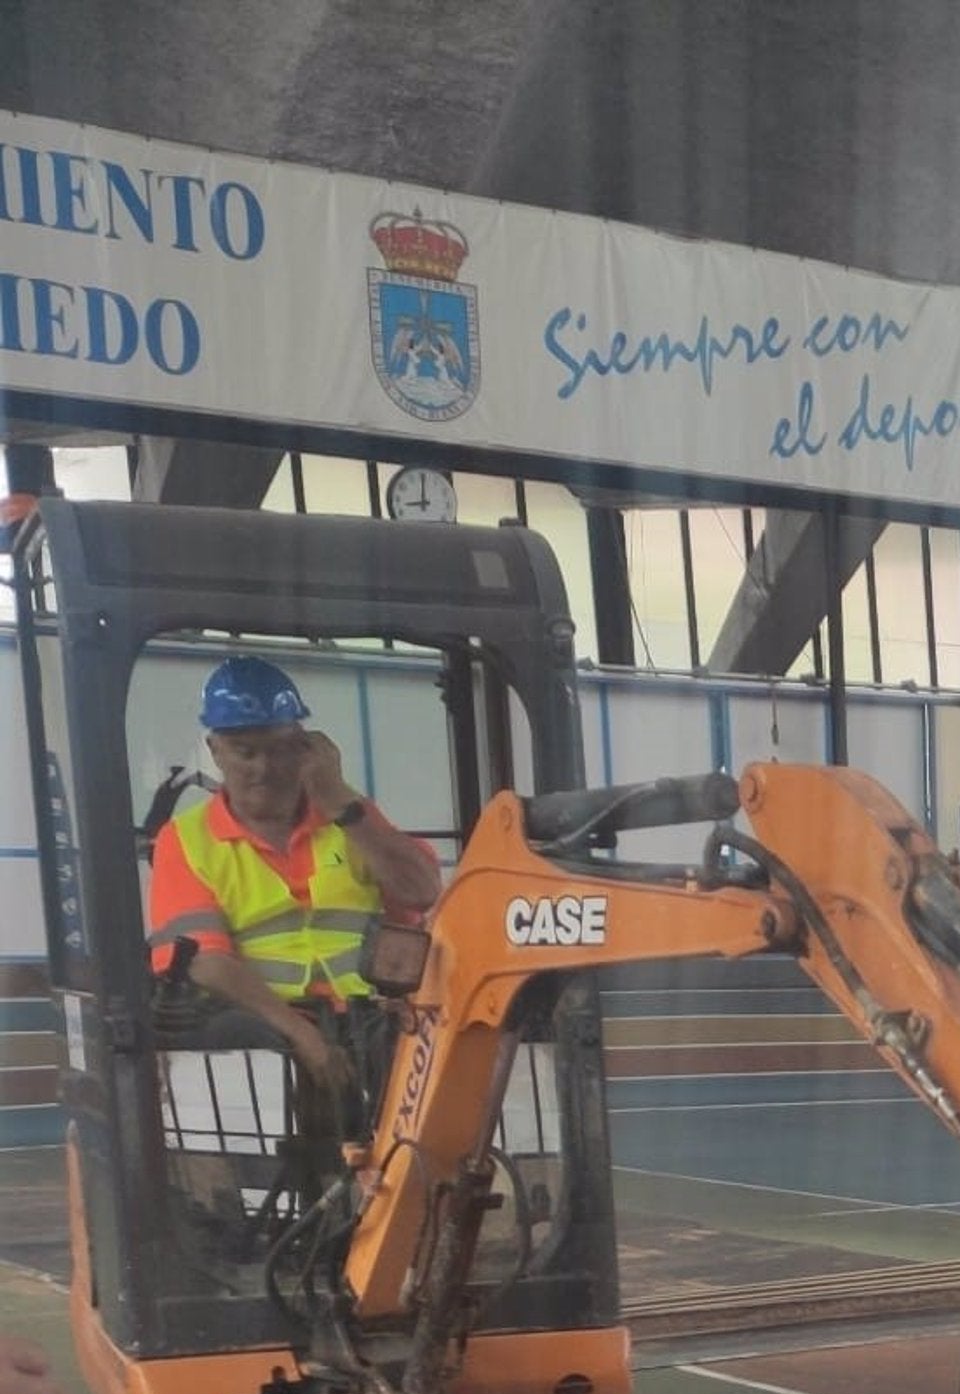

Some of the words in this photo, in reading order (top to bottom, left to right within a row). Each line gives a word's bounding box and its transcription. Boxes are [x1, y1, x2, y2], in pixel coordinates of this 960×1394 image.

[0, 143, 265, 261] IENTO
[0, 272, 201, 375] IEDO
[544, 306, 789, 398] Siempre
[803, 311, 909, 358] con
[770, 381, 828, 458] el
[504, 894, 608, 946] CASE
